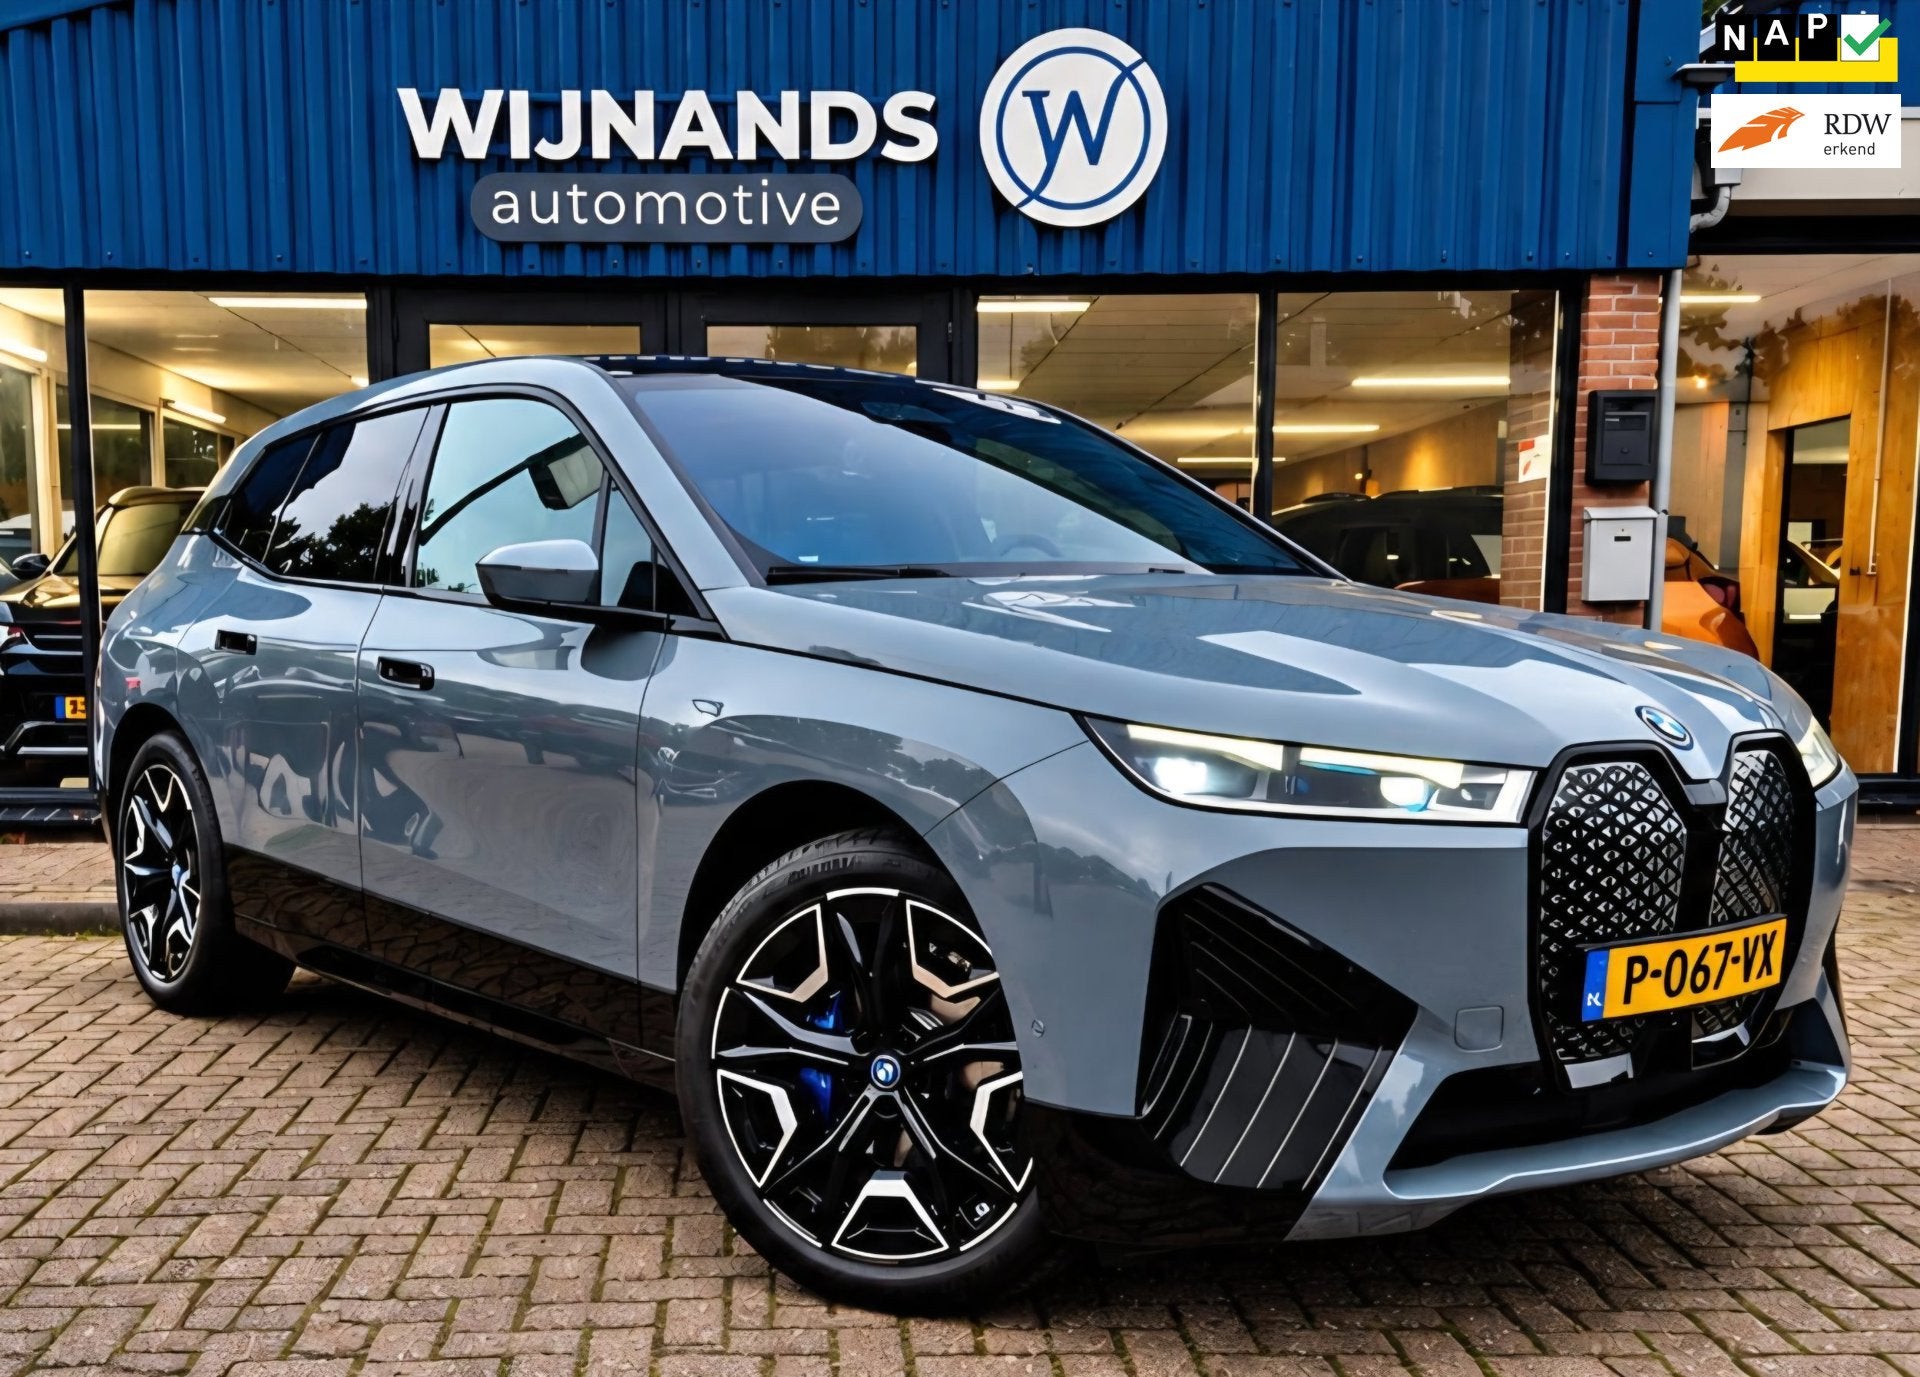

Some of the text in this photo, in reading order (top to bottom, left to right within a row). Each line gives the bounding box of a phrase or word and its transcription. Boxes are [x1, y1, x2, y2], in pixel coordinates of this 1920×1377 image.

[397, 87, 939, 162] WIJNANDS
[491, 178, 841, 226] automotive
[1622, 929, 1778, 1005] P-067-VX
